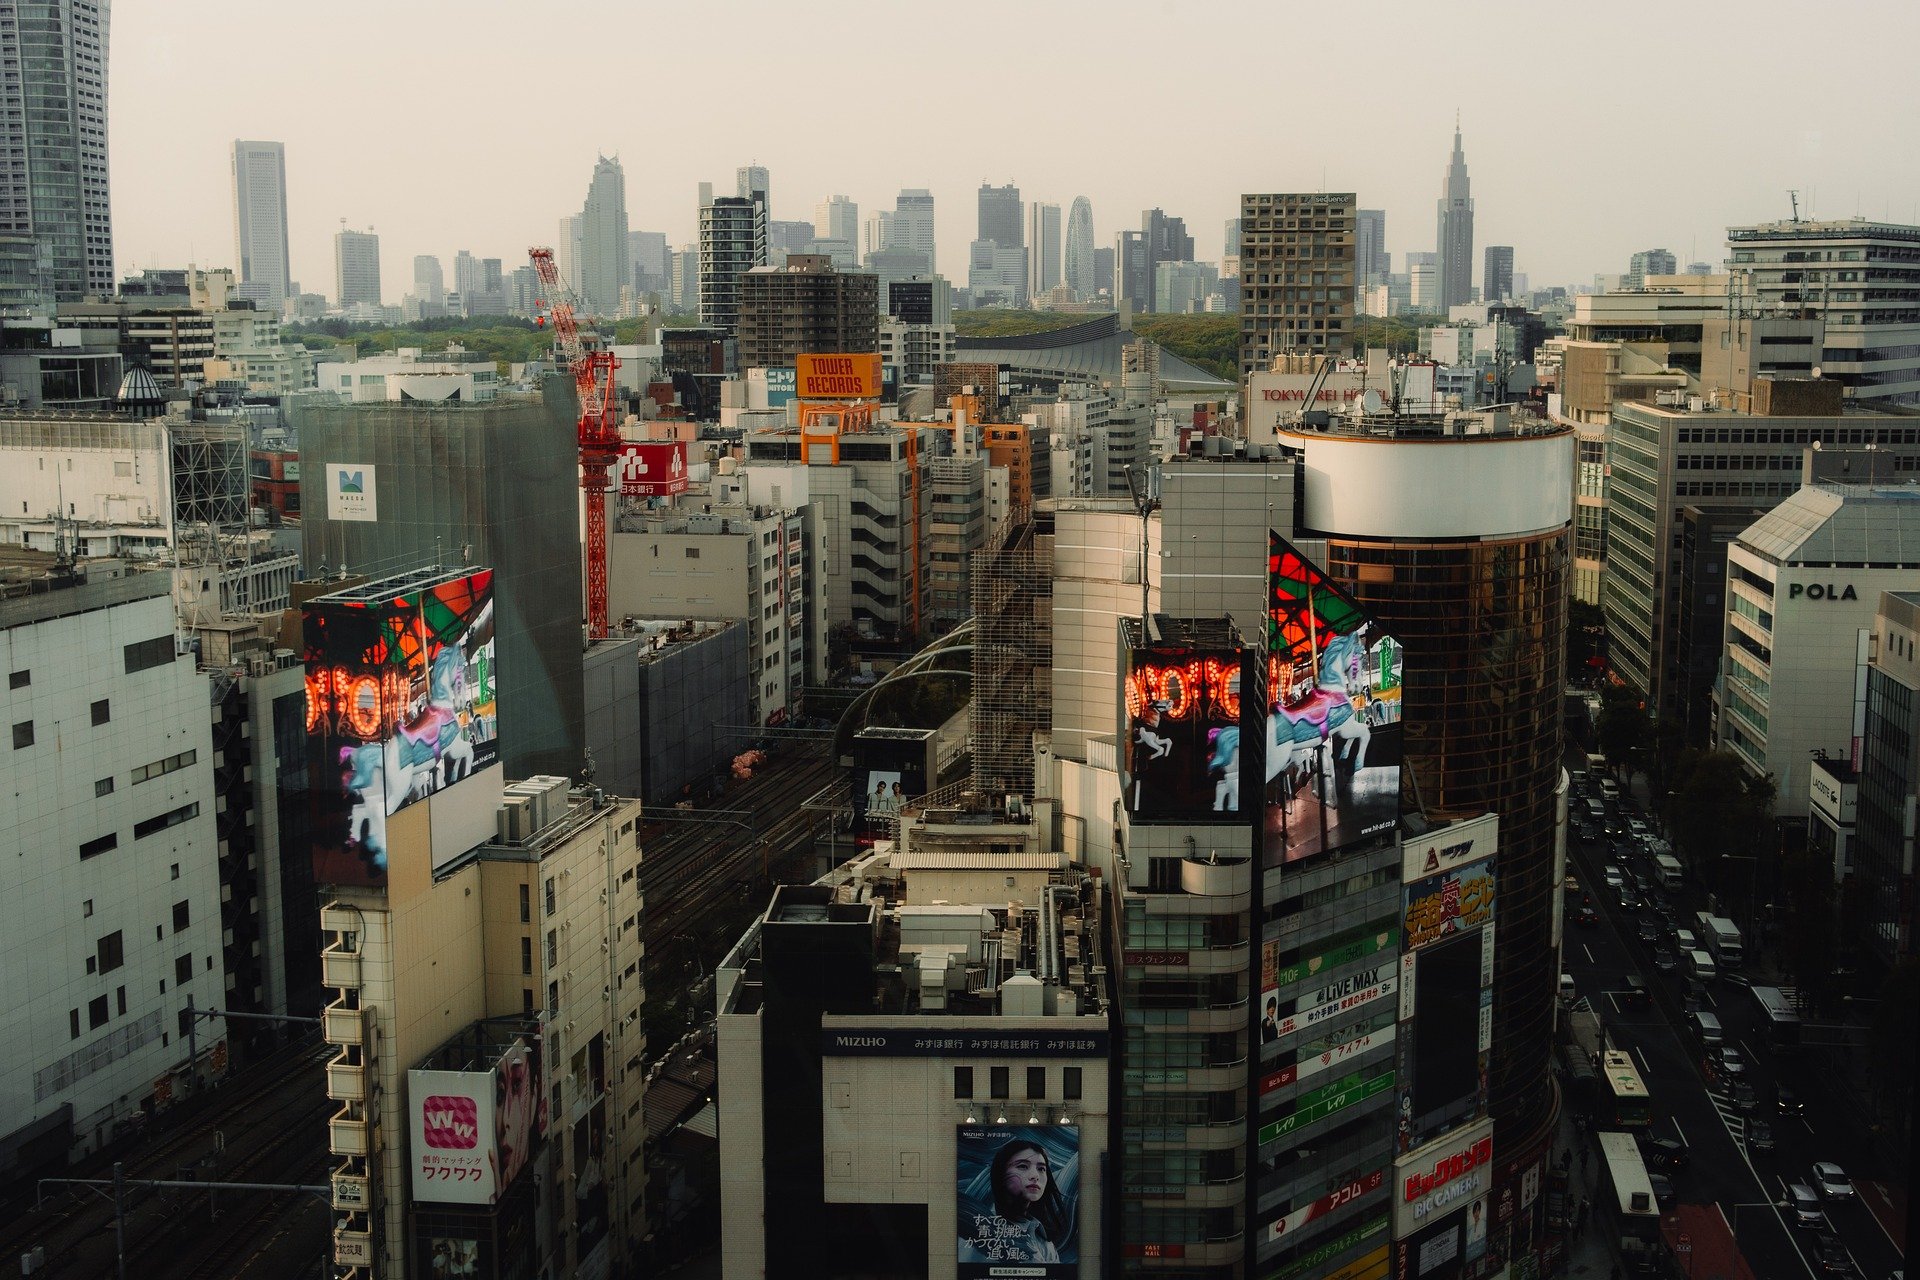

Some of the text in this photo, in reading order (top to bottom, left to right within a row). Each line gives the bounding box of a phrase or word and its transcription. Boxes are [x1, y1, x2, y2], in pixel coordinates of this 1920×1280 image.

[1315, 195, 1349, 205] sequence
[810, 358, 854, 375] TOWER
[768, 371, 796, 384] ニトリ
[806, 376, 863, 394] RECORDS
[1316, 389, 1337, 401] REI
[1789, 583, 1858, 600] POLA
[1812, 776, 1830, 798] LACOSTE
[1353, 968, 1379, 991] MAX
[1307, 1003, 1340, 1023] 仲介手数料
[1341, 988, 1379, 1010] 家賃の半月分
[836, 1036, 886, 1047] MIZUHO
[914, 1038, 1097, 1050] みずほ銀行 みずほ信託銀行 みずほ証券
[1338, 1036, 1371, 1058] アイフル
[1327, 1095, 1345, 1111] レイク
[1275, 1116, 1295, 1134] レイク
[422, 1155, 482, 1165] 劇的マッチング
[1404, 1136, 1492, 1201] ビックカメラ
[422, 1166, 482, 1181] ワクワク
[1330, 1172, 1382, 1210] アコム 5F
[1414, 1173, 1480, 1220] BIC CAMERA
[973, 1213, 1007, 1226] すべての
[1303, 1232, 1360, 1267] マインドフルネス
